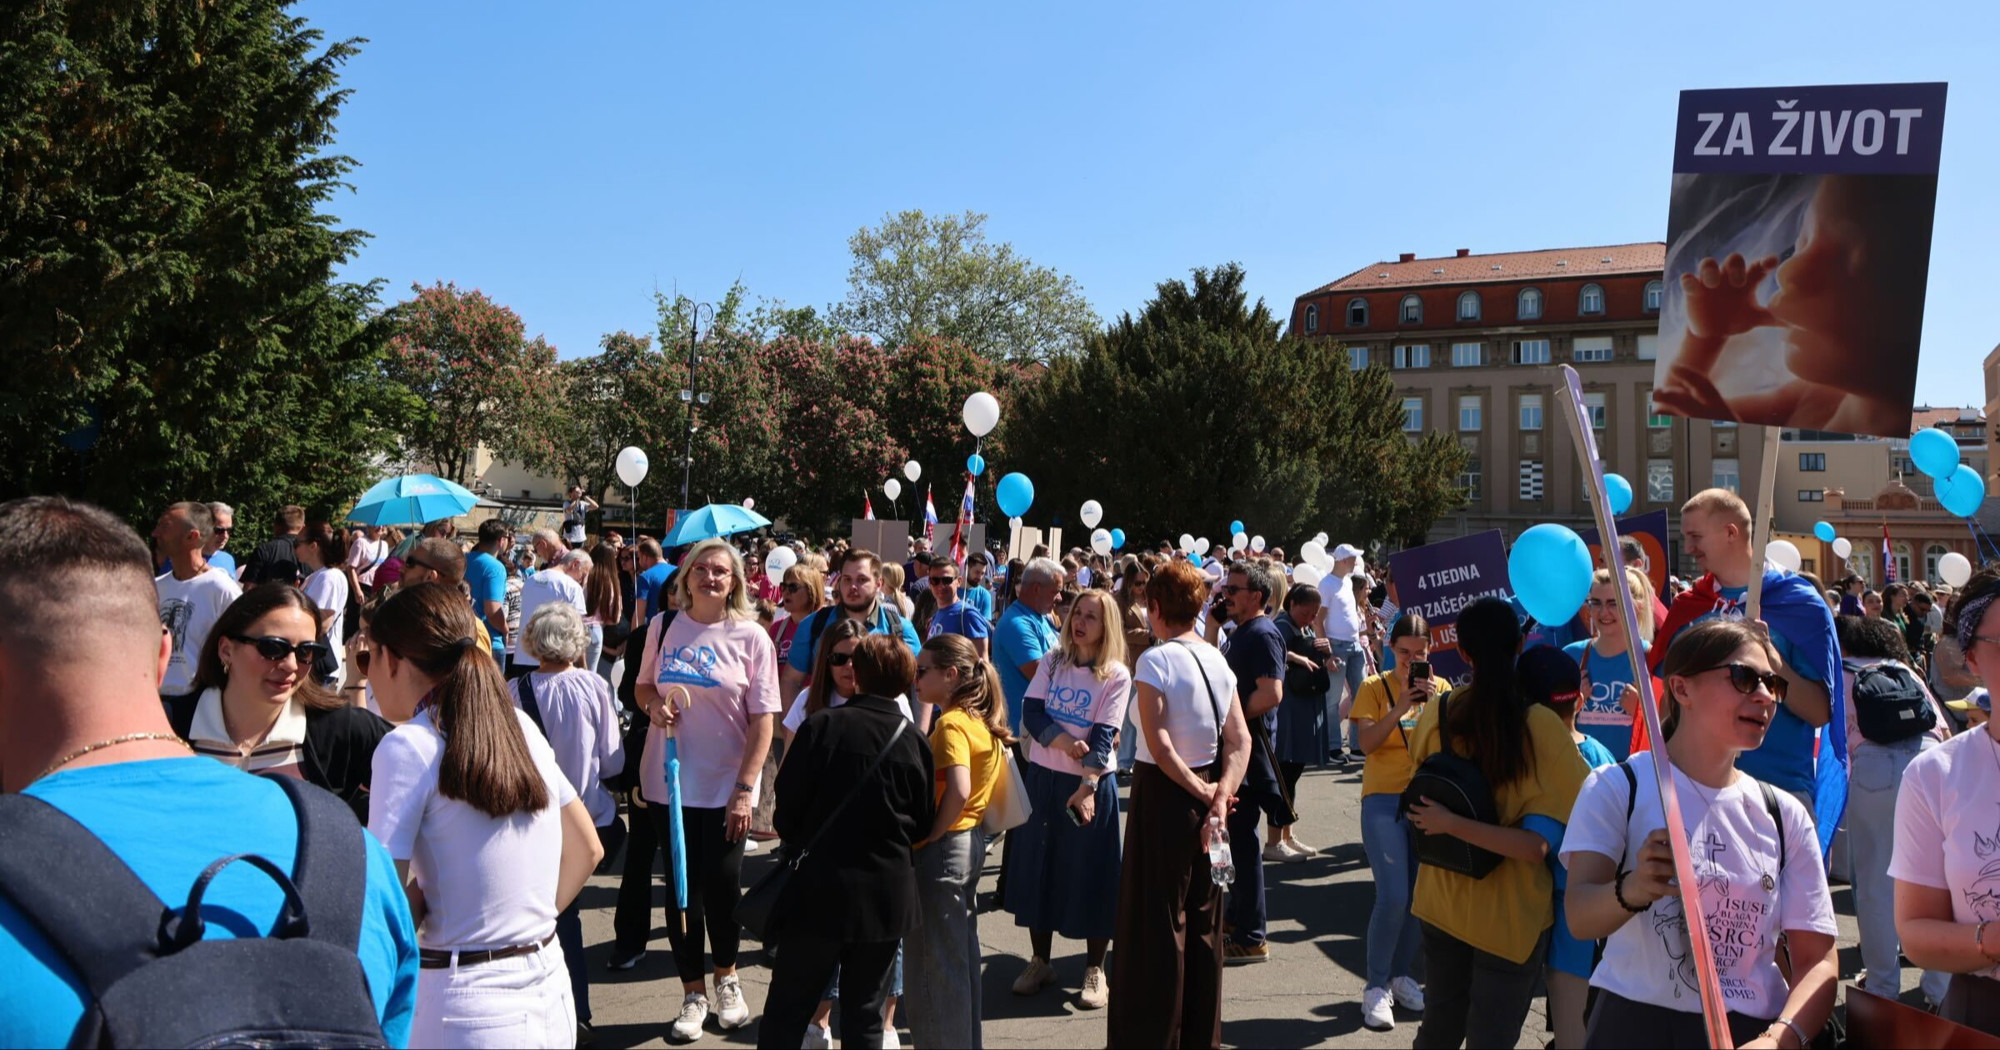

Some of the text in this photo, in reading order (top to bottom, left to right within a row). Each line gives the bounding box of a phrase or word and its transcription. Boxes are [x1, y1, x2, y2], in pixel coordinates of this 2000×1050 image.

[1693, 99, 1923, 156] ZA ŽIVOT
[1418, 563, 1481, 590] 4 TJEDNA
[1440, 624, 1459, 644] UŠ
[662, 645, 717, 668] HOD
[1449, 673, 1473, 688] HO
[1047, 680, 1092, 709] HOD
[1590, 680, 1627, 702] OD
[1592, 700, 1625, 714] ŽIVO
[1720, 910, 1751, 922] BLAGA
[1725, 898, 1769, 916] ISUSE
[1709, 925, 1765, 950] SRCA
[1711, 942, 1744, 959] ČINI
[1722, 987, 1756, 1001] OME!
